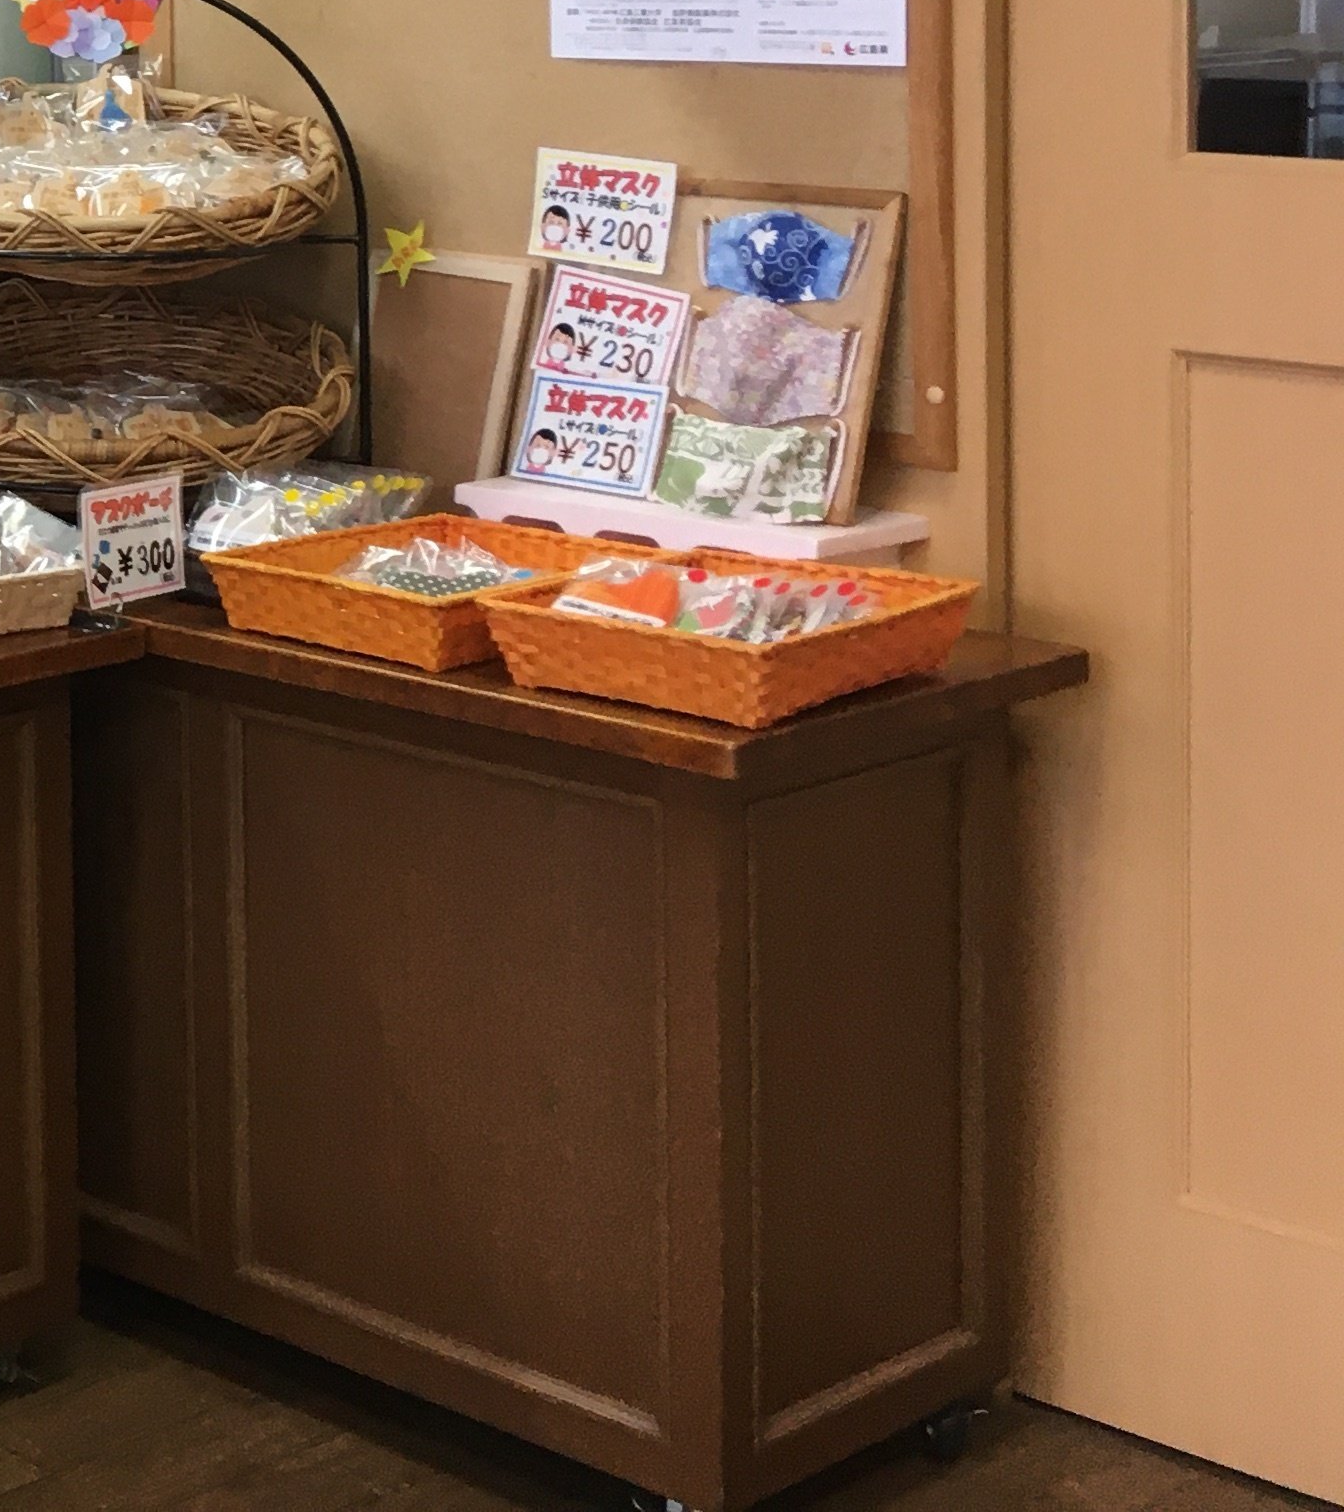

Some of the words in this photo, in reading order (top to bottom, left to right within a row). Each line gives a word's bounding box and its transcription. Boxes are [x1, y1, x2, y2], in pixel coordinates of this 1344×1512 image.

[555, 161, 662, 198] 立体マスク
[564, 282, 669, 328] 立体マスク
[543, 383, 649, 423] 立体マスク
[116, 537, 176, 578] ¥300
